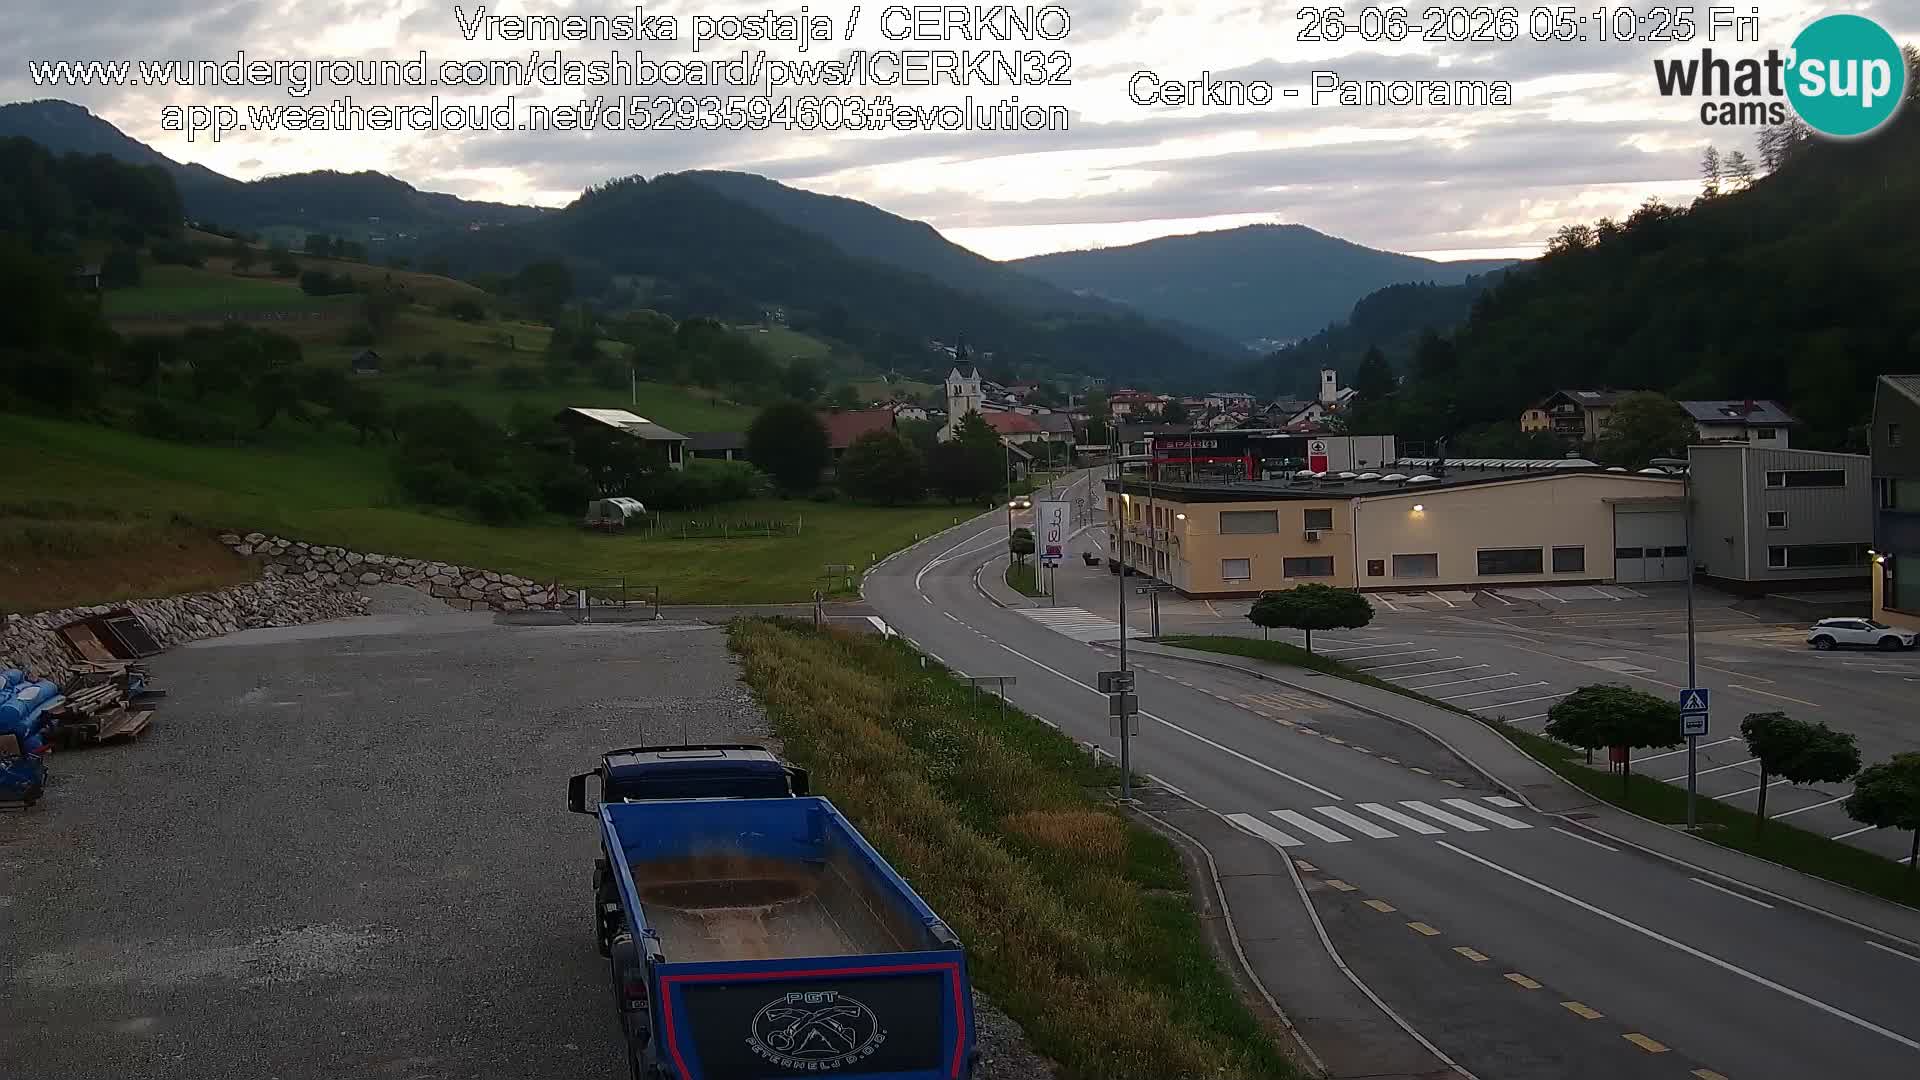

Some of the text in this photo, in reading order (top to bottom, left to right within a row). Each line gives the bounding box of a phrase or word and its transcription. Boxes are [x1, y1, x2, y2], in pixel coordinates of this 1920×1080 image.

[1166, 440, 1202, 449] SPAR
[786, 991, 838, 1004] PGT
[745, 1036, 841, 1070] PETERNELJ
